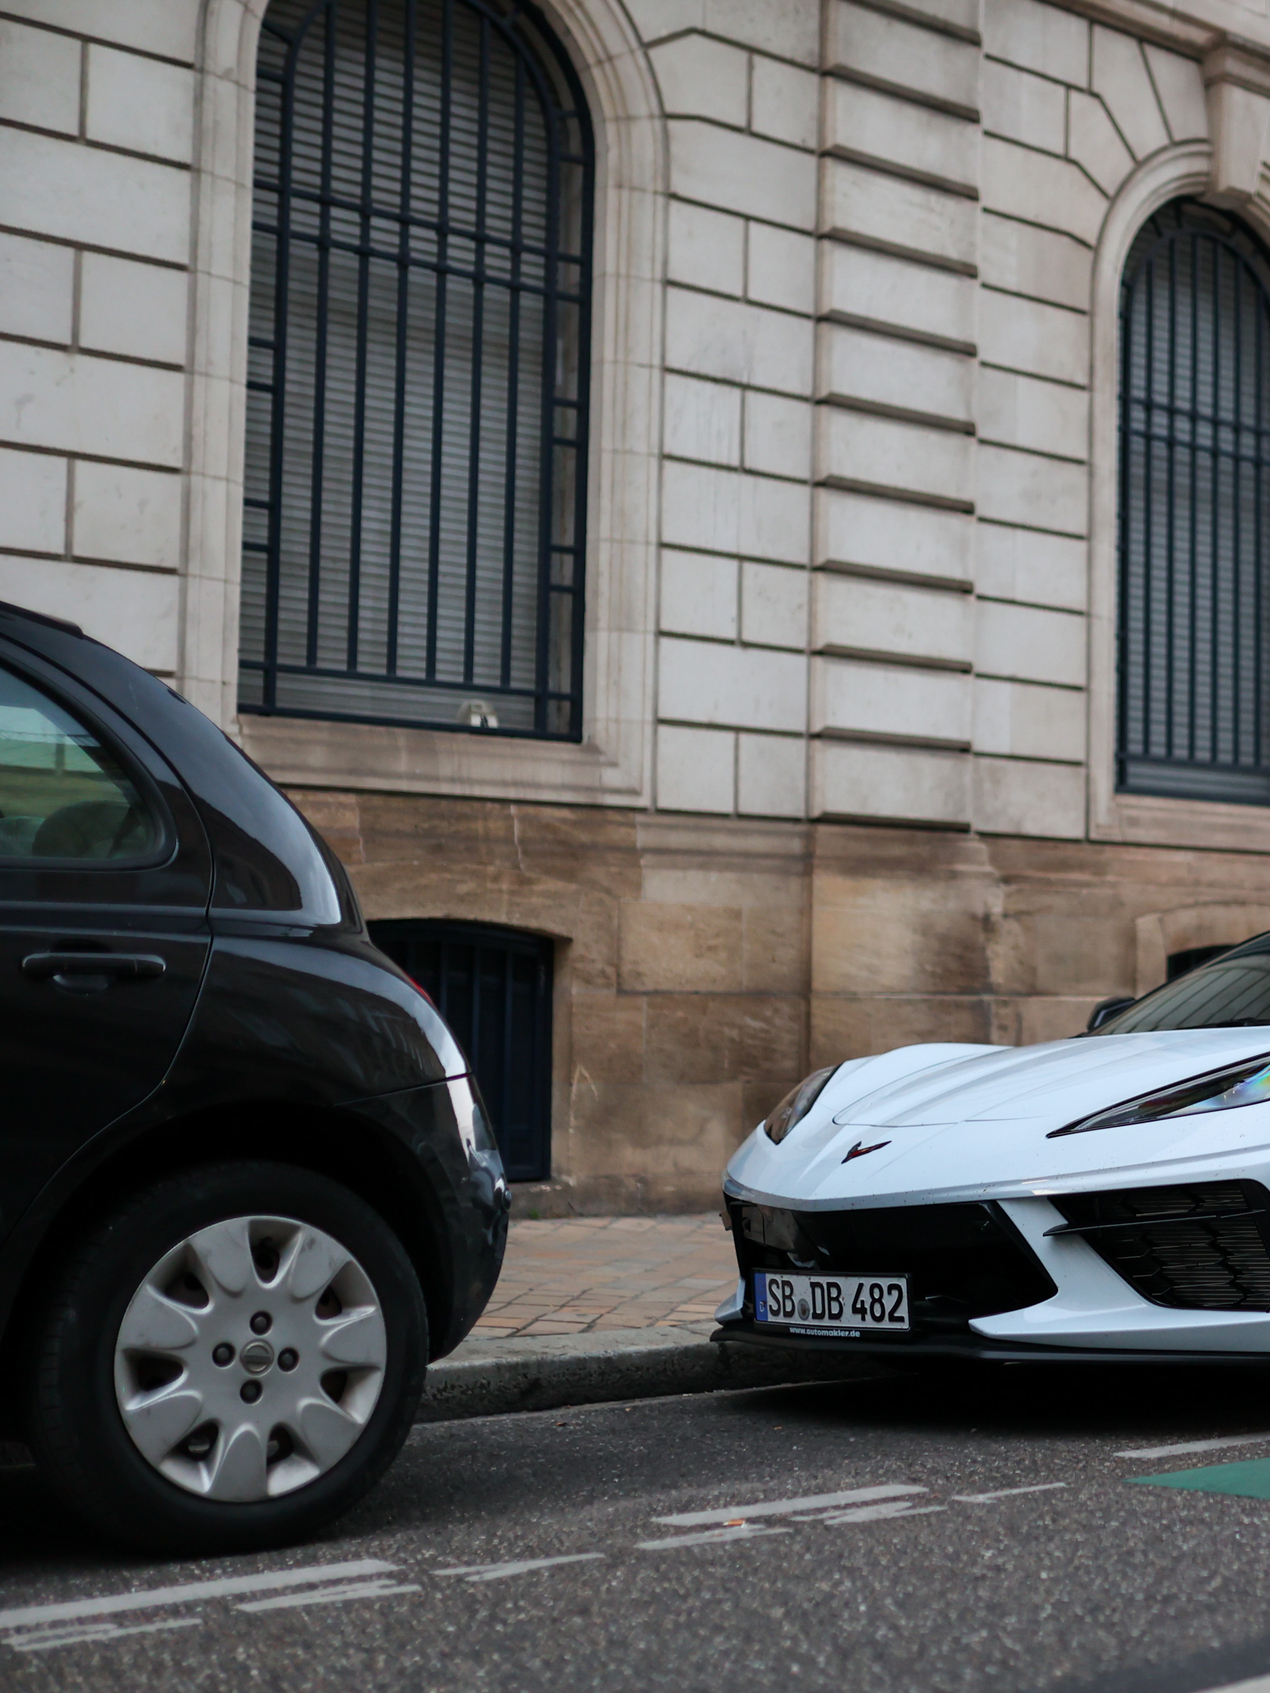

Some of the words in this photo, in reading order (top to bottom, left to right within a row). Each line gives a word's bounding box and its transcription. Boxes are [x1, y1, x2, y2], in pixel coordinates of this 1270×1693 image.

[768, 1278, 796, 1318] SB
[810, 1281, 844, 1321] DB
[852, 1282, 905, 1323] 482
[789, 1327, 860, 1338] www.automakler.de
